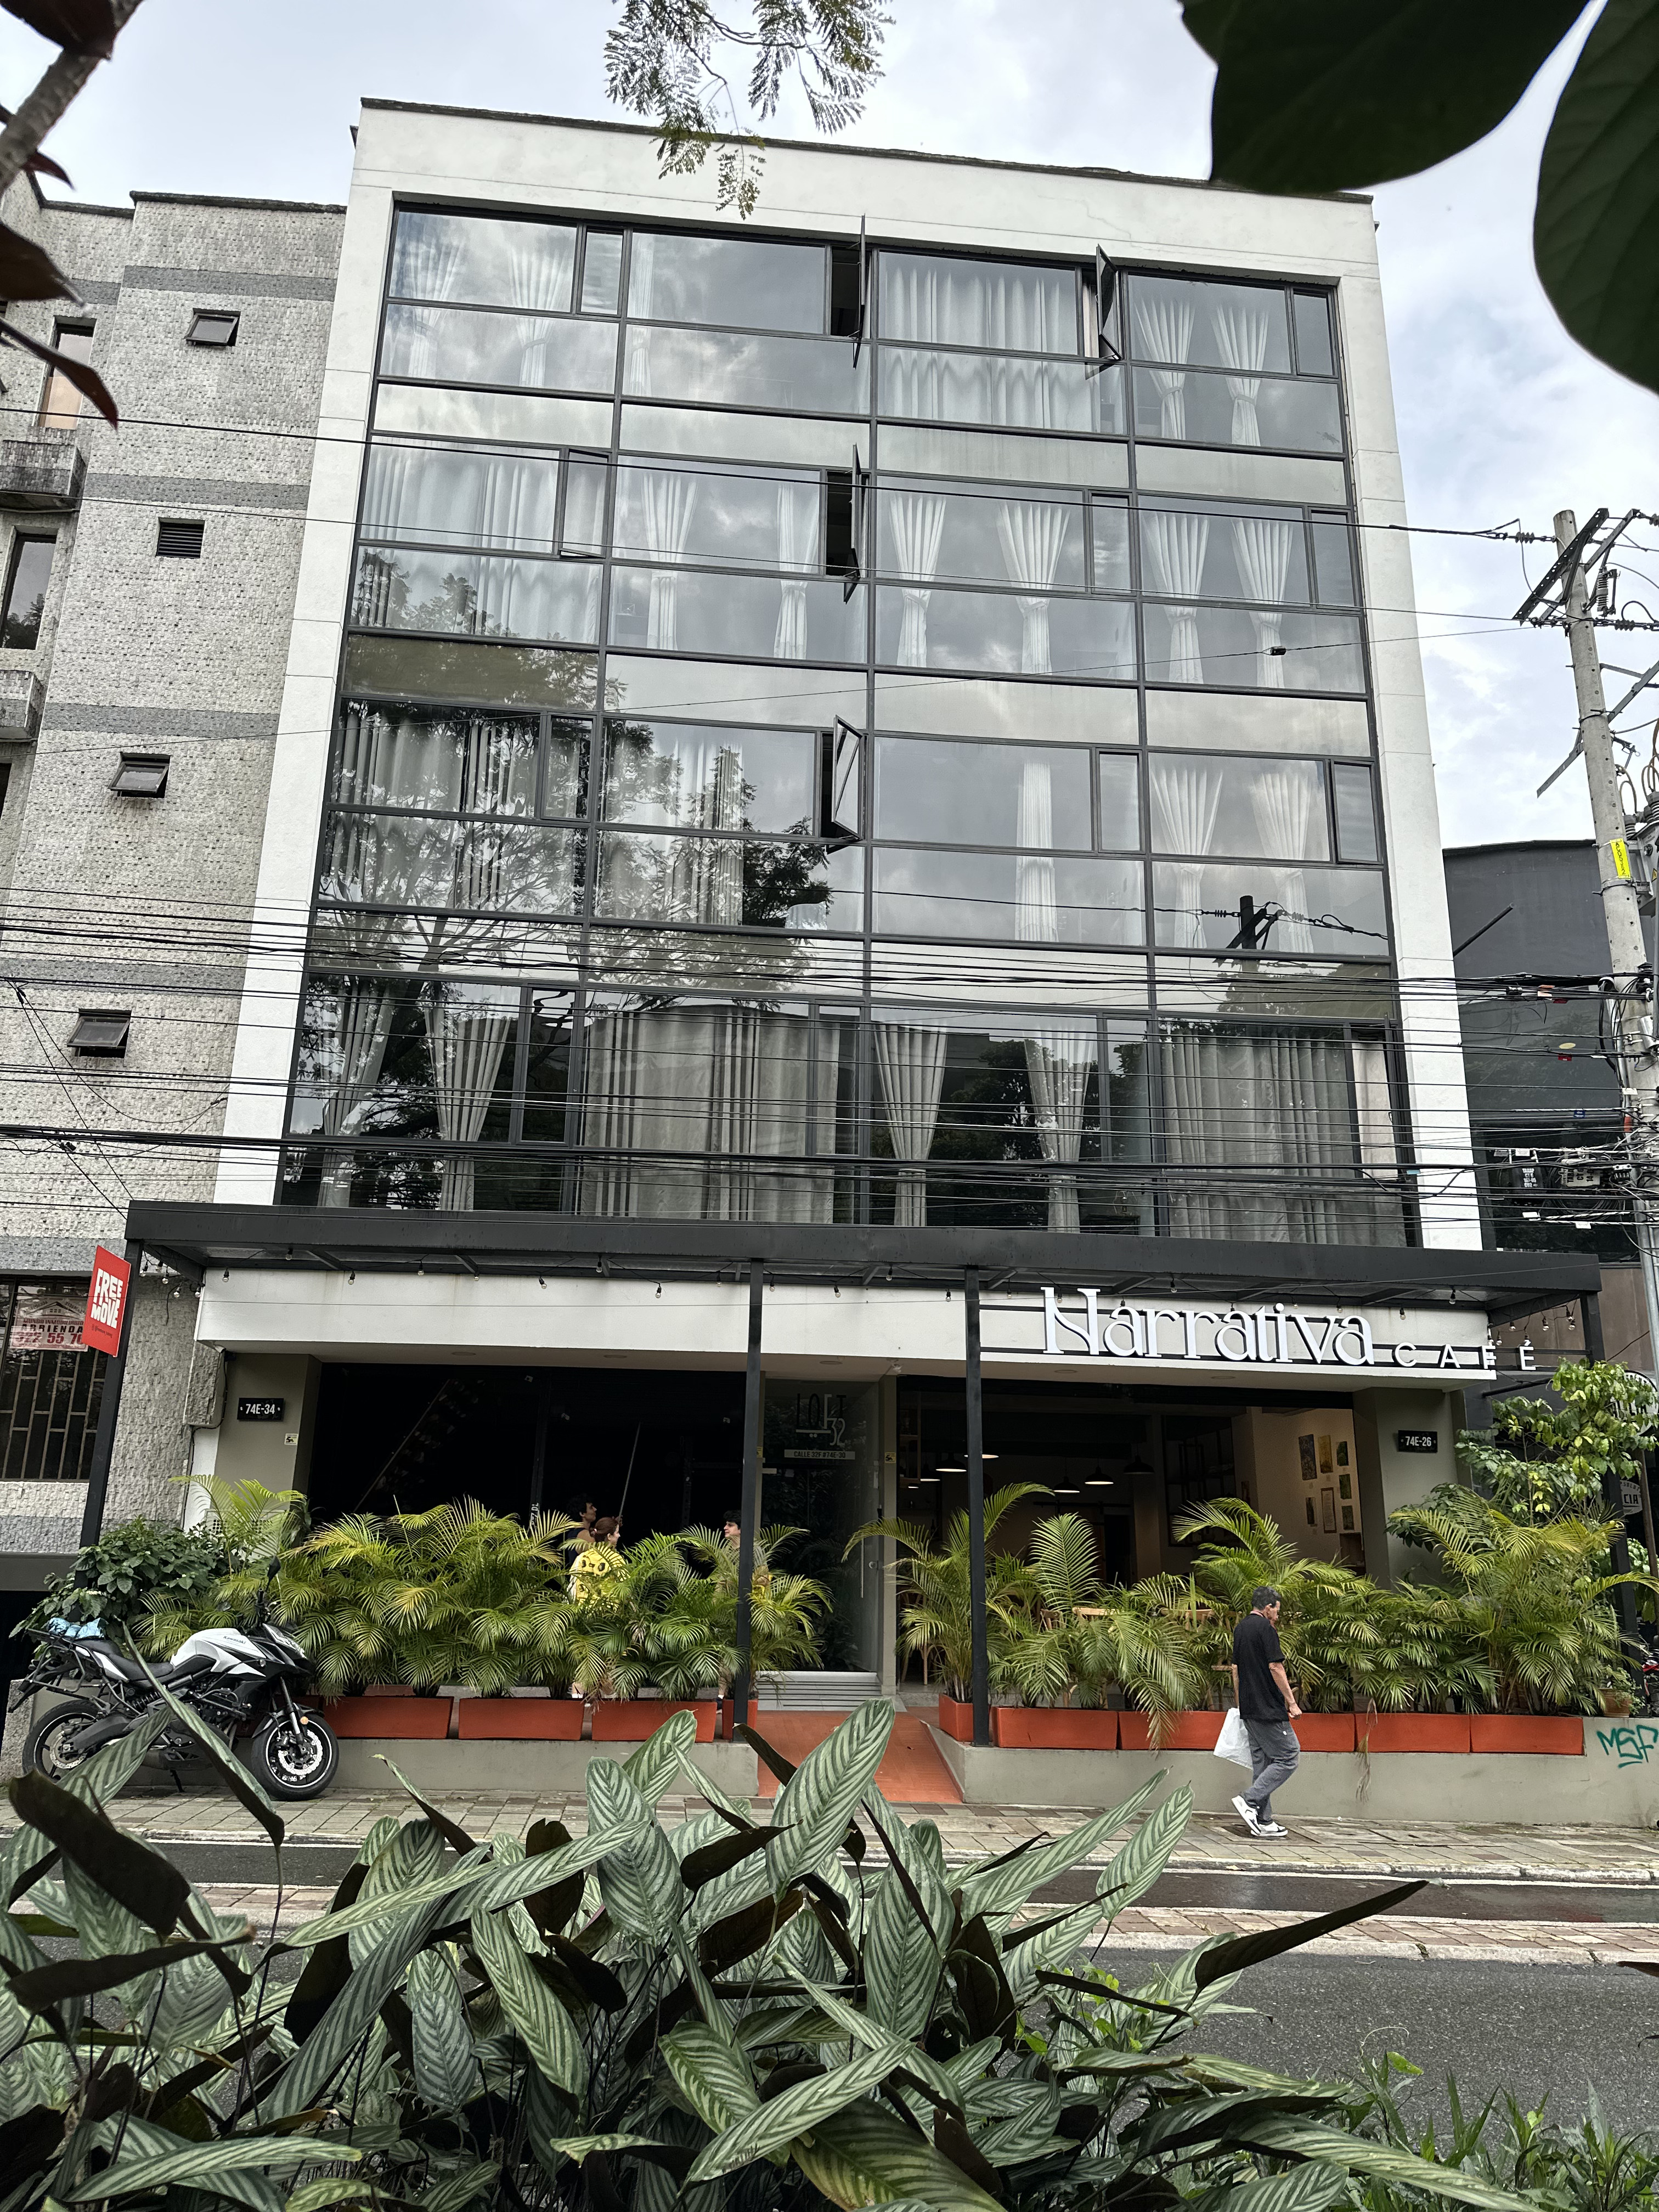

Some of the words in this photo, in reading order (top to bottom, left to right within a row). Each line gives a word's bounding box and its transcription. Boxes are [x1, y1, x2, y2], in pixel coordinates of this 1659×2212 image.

[93, 1268, 123, 1306] FREE
[91, 1298, 121, 1329] MOVE
[47, 1333, 64, 1344] 55
[1041, 1286, 1374, 1365] Narrativa
[1394, 1339, 1536, 1370] CAFÉ
[245, 1404, 275, 1414] 74E-34
[1405, 1436, 1431, 1447] 74E-26
